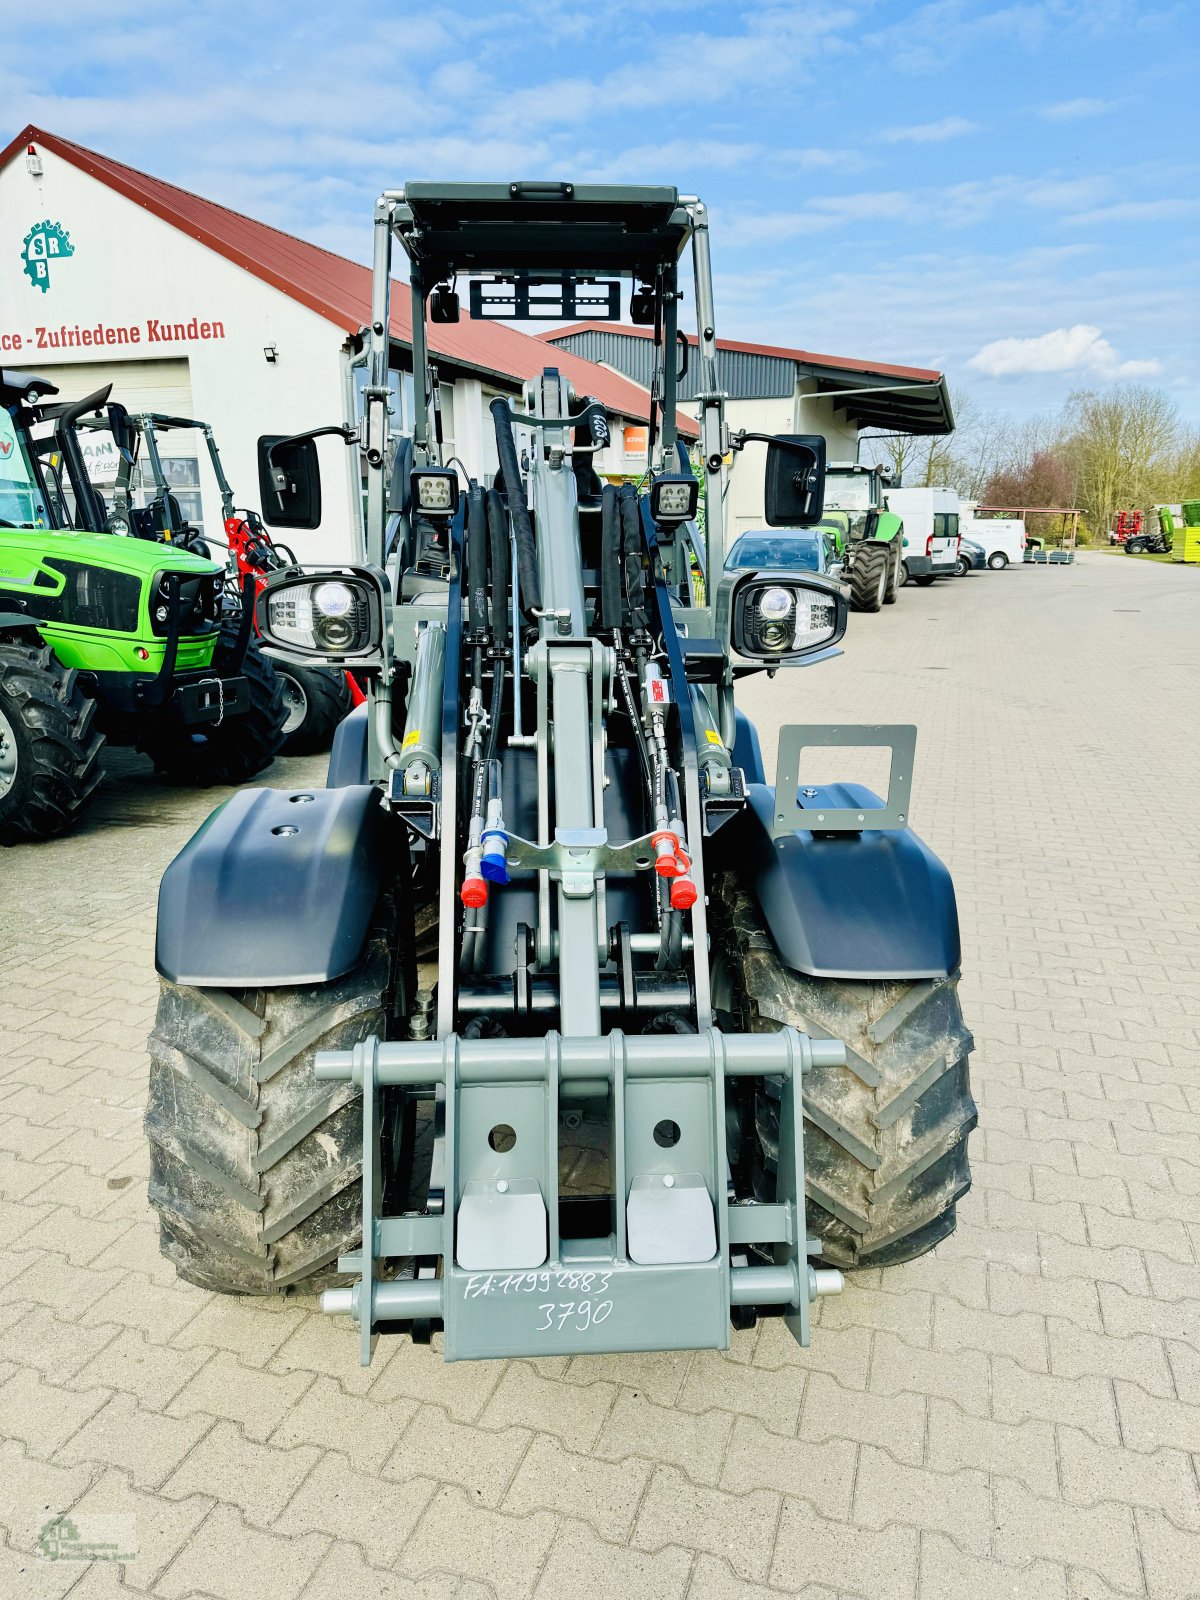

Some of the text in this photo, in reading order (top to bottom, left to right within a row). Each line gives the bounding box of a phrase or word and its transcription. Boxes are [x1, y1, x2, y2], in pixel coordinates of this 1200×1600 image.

[35, 324, 140, 349] Zufriedene
[147, 317, 225, 342] Kunden
[536, 1300, 614, 1331] 3790
